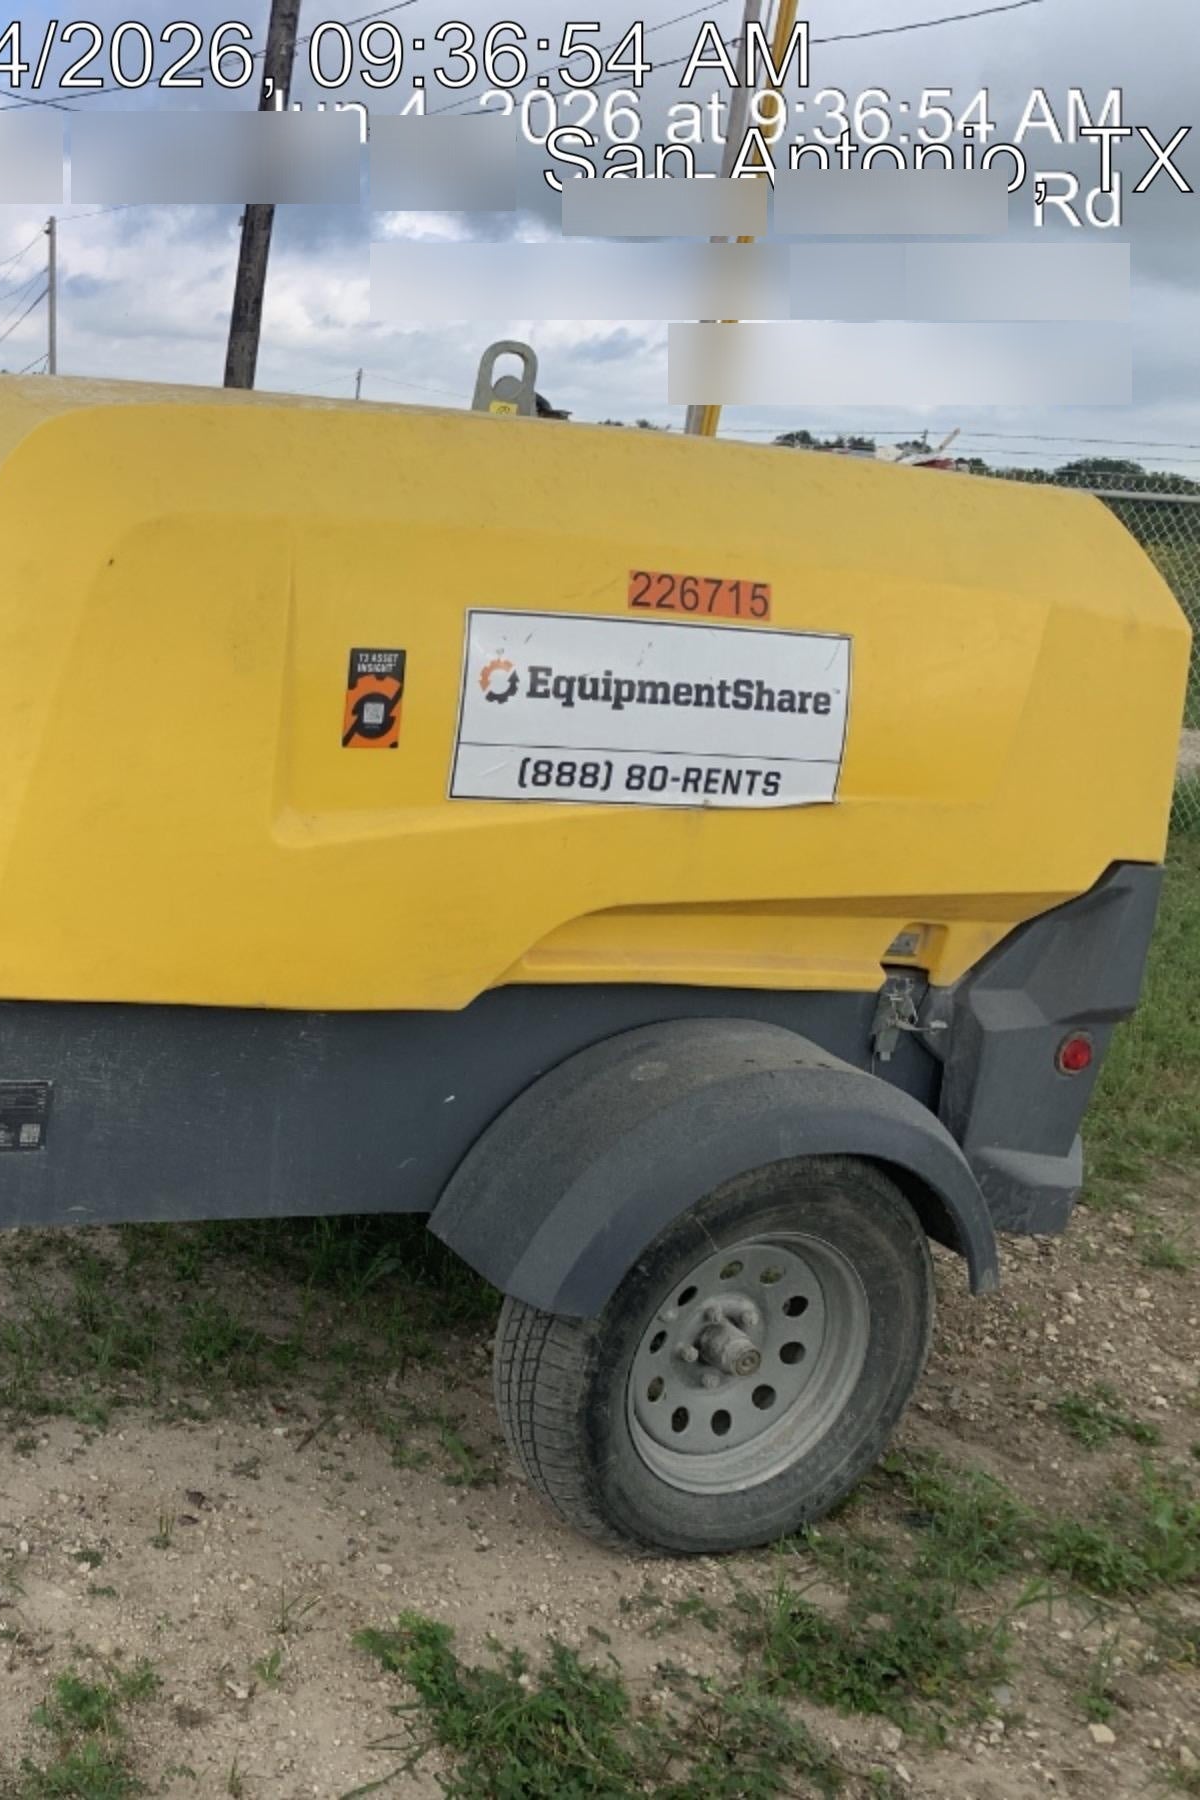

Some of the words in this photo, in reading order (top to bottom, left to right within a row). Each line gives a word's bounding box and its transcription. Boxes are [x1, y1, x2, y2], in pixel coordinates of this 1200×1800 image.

[631, 571, 769, 617] 226715
[526, 665, 832, 715] EquipmentShare
[518, 757, 613, 792] (888)
[625, 764, 782, 797] 80-RENTS
